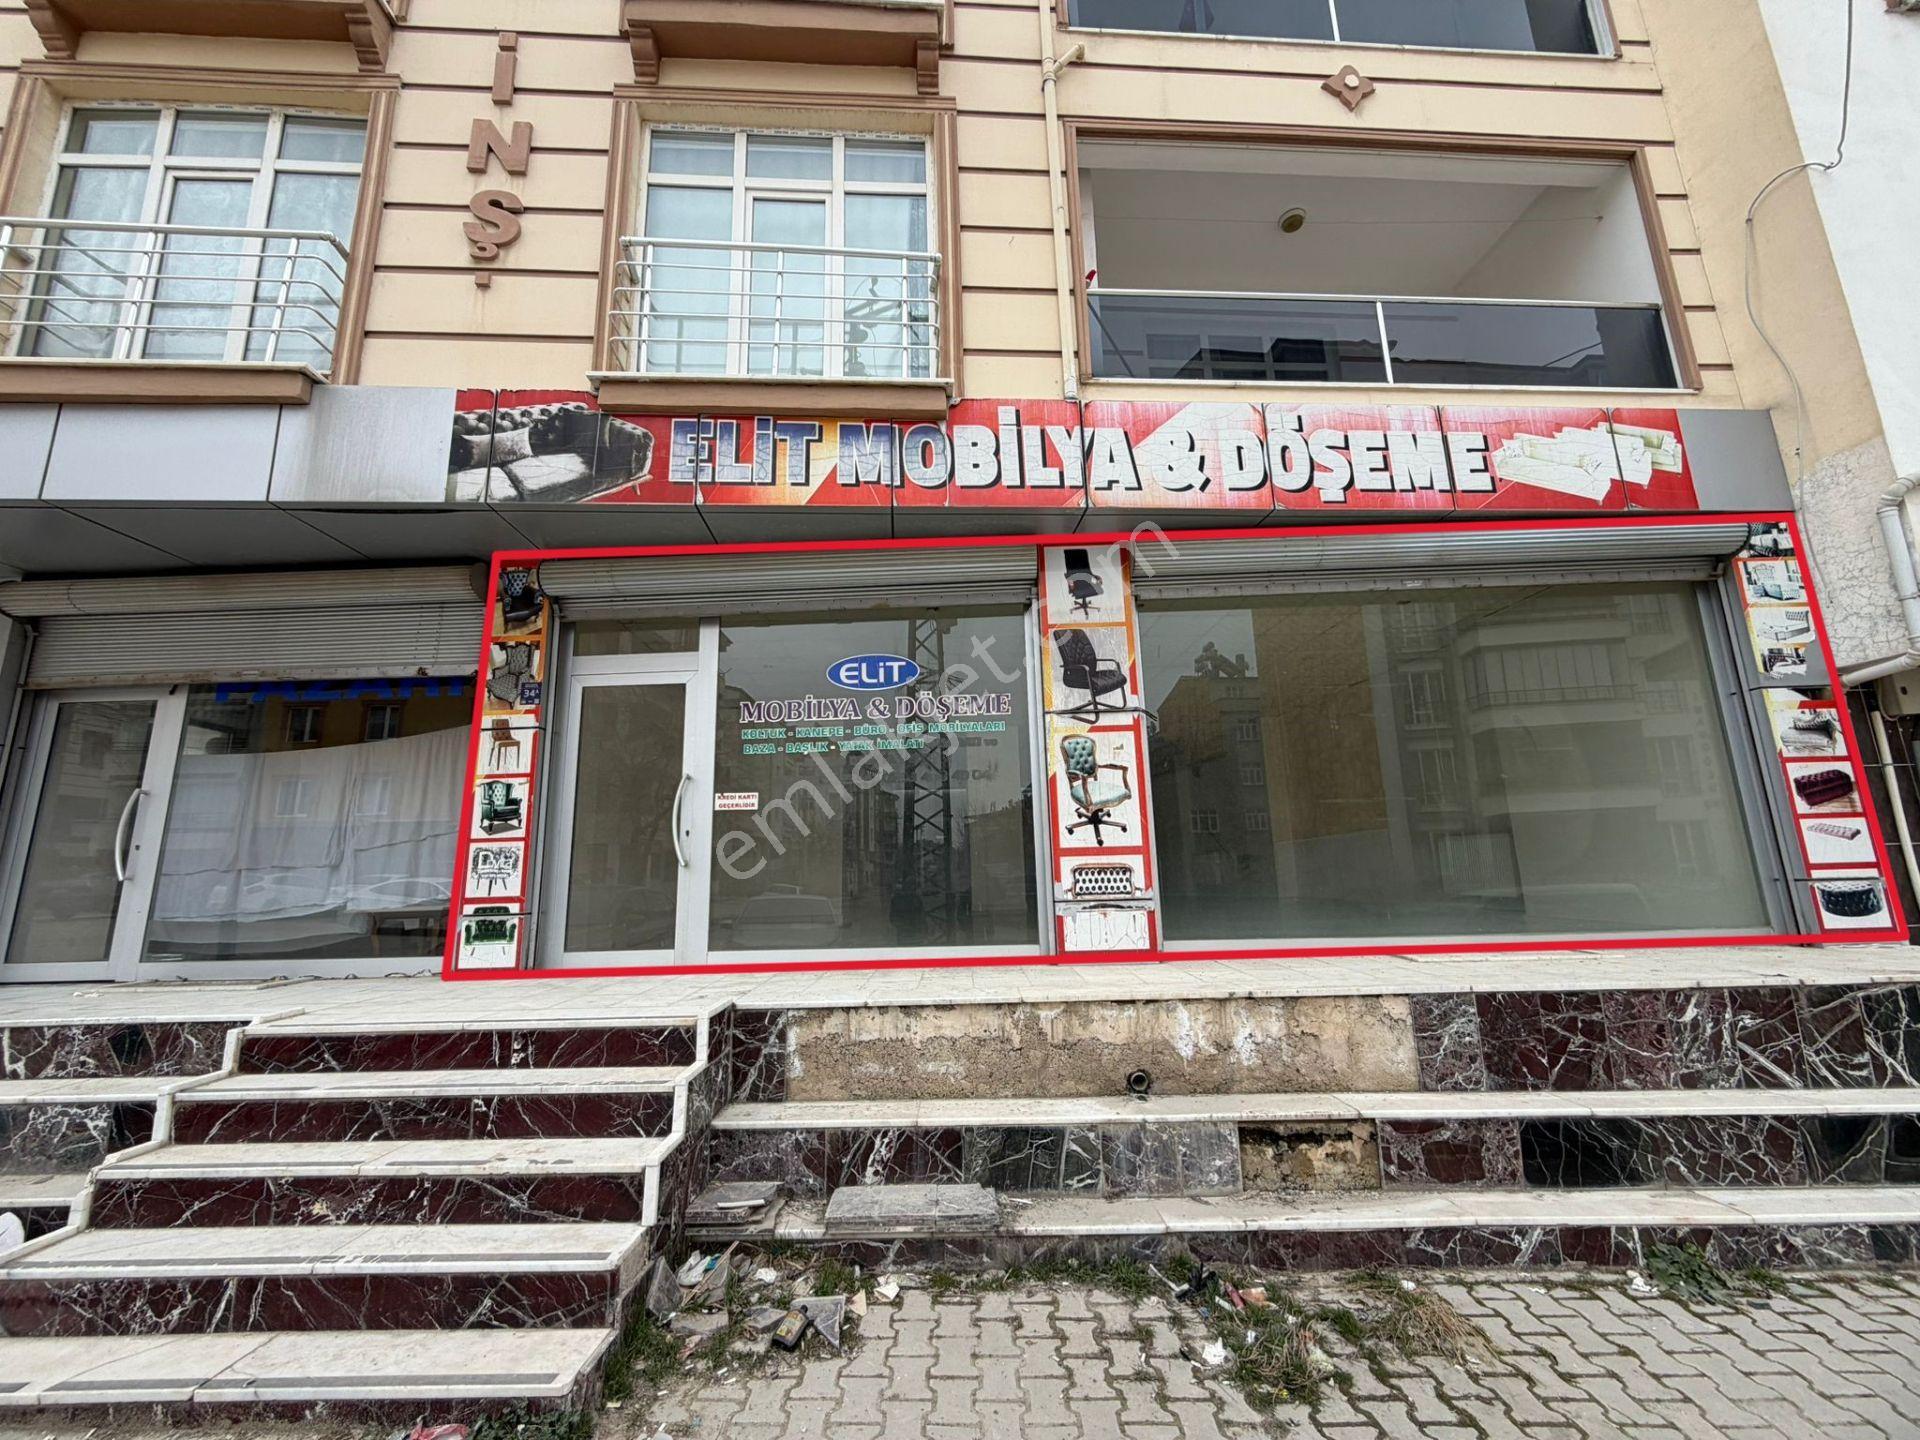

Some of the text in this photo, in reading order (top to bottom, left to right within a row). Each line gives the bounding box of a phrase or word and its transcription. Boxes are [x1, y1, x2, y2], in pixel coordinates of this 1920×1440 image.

[836, 405, 1142, 491] MOBİLYA
[1153, 430, 1210, 493] &
[1222, 411, 1497, 503] DÖŞEME
[739, 691, 1012, 724] MOBİLYA & DÖŞEME
[741, 727, 787, 740] KOLTUK
[795, 726, 844, 739] KANEPE
[853, 723, 888, 737] BÜRO
[896, 721, 925, 734] OFİS
[927, 719, 1006, 733] MOBİLYALARI
[743, 743, 777, 755] BAZA
[785, 741, 829, 756] BAŞLIK
[876, 737, 924, 750] İMALATI
